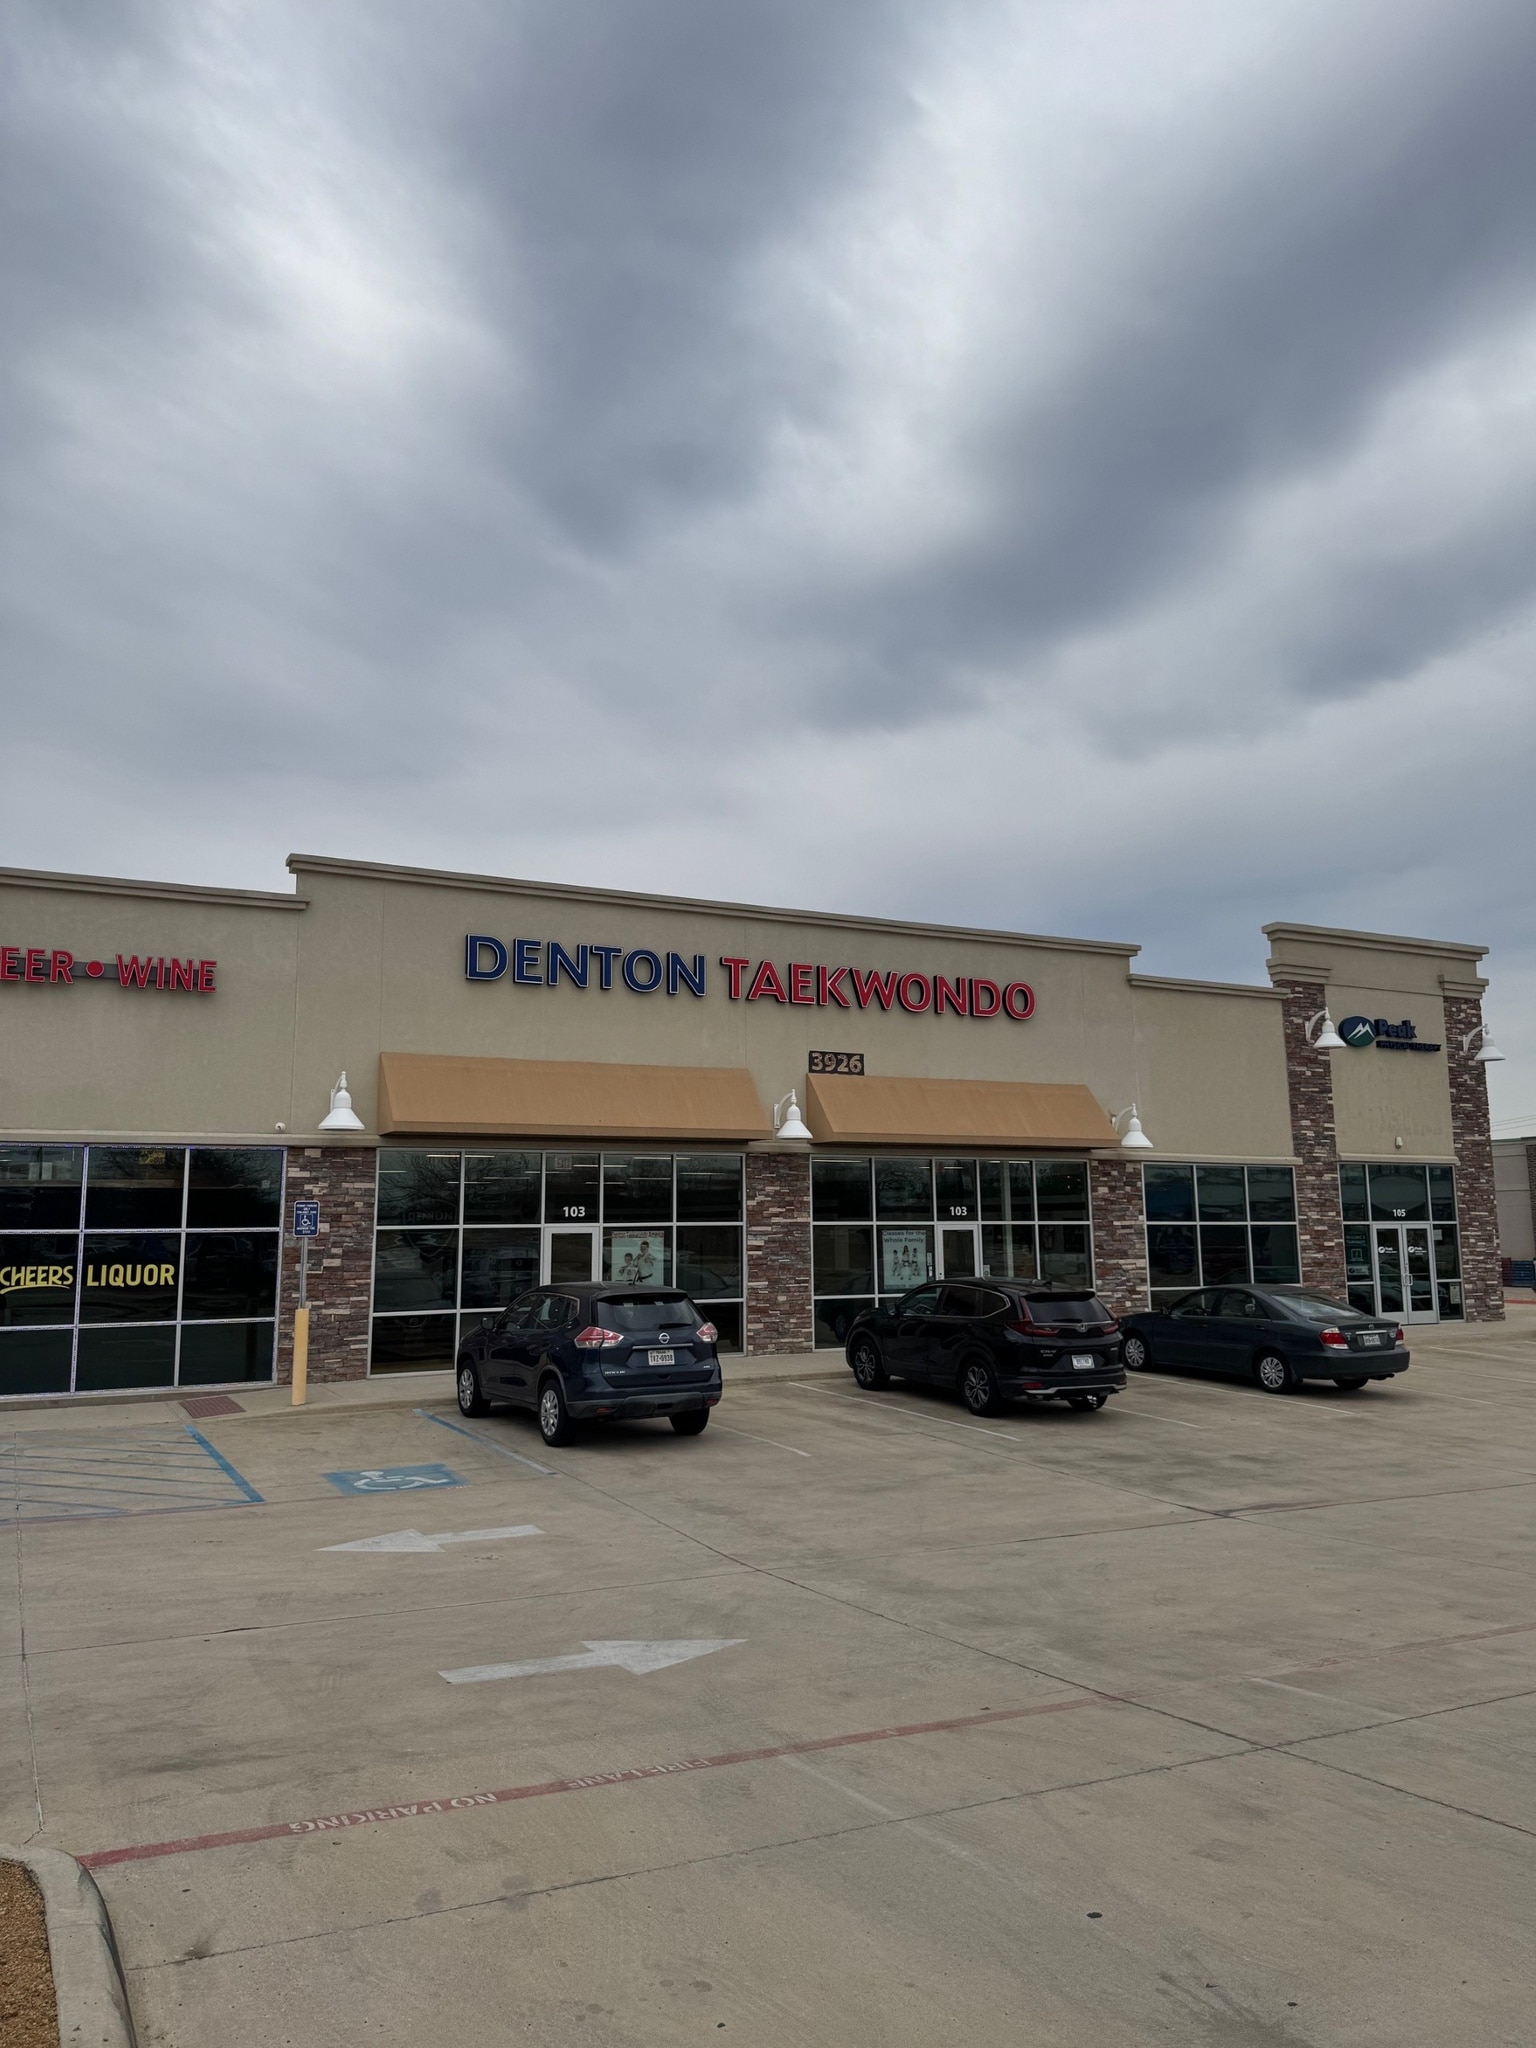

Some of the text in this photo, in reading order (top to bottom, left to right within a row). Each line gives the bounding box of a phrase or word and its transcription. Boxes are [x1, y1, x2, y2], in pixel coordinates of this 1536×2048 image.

[115, 953, 217, 992] WINE
[466, 934, 1037, 1020] DENTON TAEKWONDO
[1374, 1018, 1417, 1039] Peak
[811, 1052, 863, 1074] 3926
[562, 1206, 586, 1218] 103
[949, 1206, 968, 1216] 103
[1392, 1209, 1406, 1217] 105
[0, 1264, 175, 1287] CHEERS LIQUOR
[564, 1758, 712, 1789] FIRE LANE
[289, 1793, 498, 1833] NO PARKING
